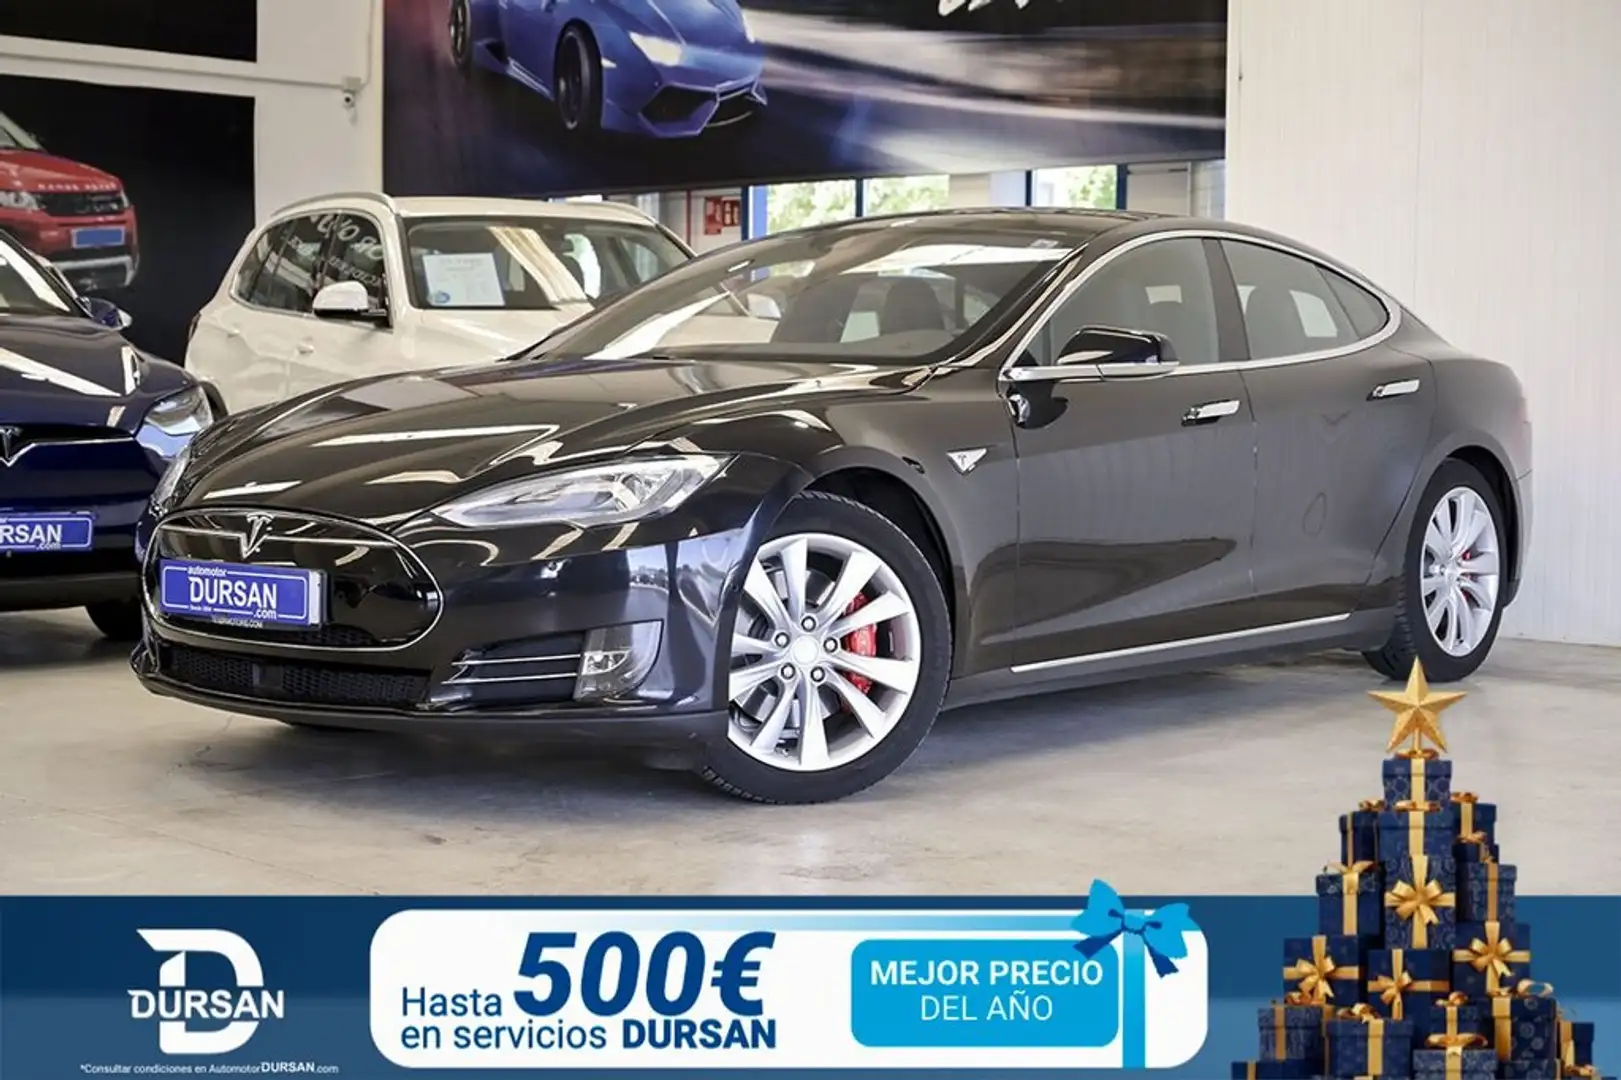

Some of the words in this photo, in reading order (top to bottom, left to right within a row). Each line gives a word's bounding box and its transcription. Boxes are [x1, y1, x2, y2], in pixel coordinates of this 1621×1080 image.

[187, 566, 227, 577] automotor
[187, 576, 277, 609] DURSAN
[253, 607, 277, 620] .com
